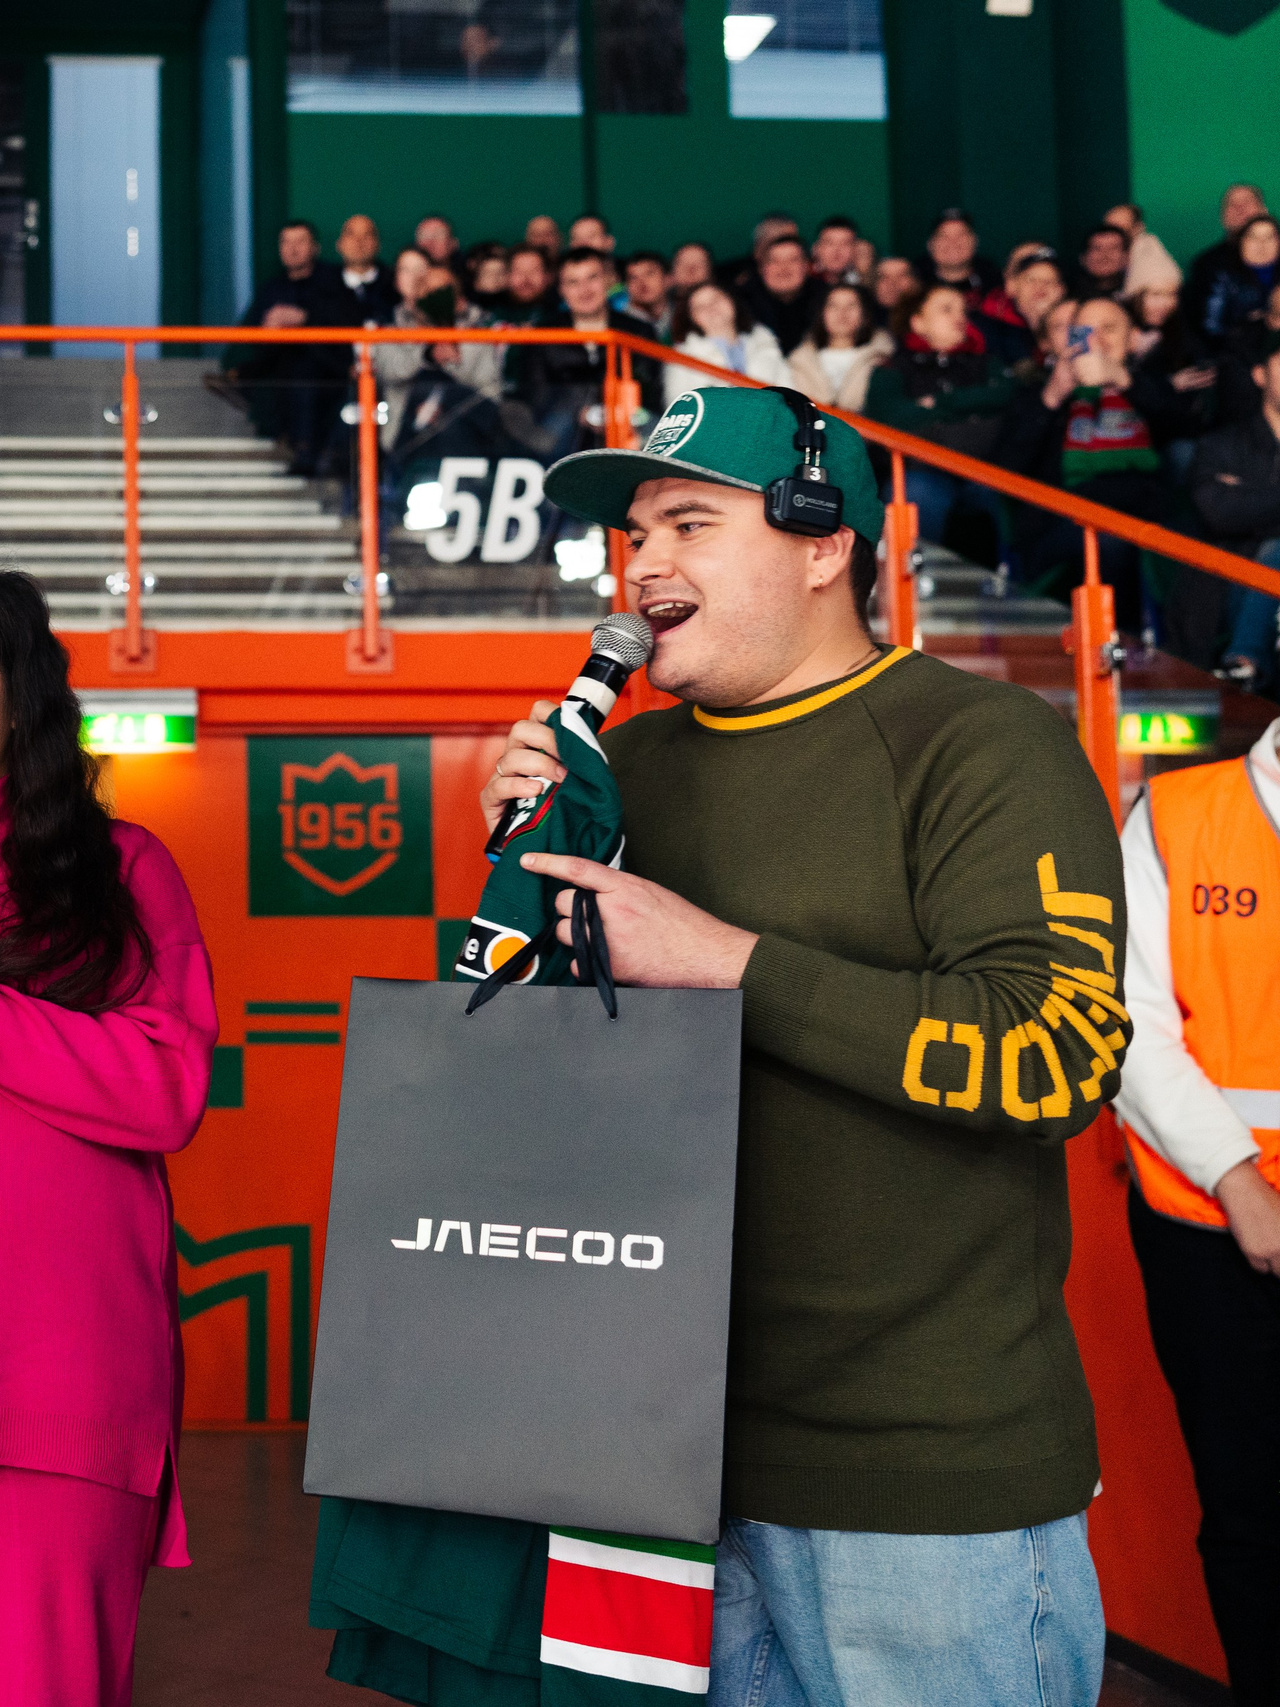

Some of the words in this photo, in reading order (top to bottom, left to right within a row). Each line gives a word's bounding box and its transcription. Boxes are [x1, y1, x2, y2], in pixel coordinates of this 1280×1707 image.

[809, 467, 822, 481] 3
[425, 456, 546, 563] 5B
[277, 802, 404, 850] 1956
[1192, 884, 1258, 918] 039
[390, 1217, 665, 1270] JAECOO
